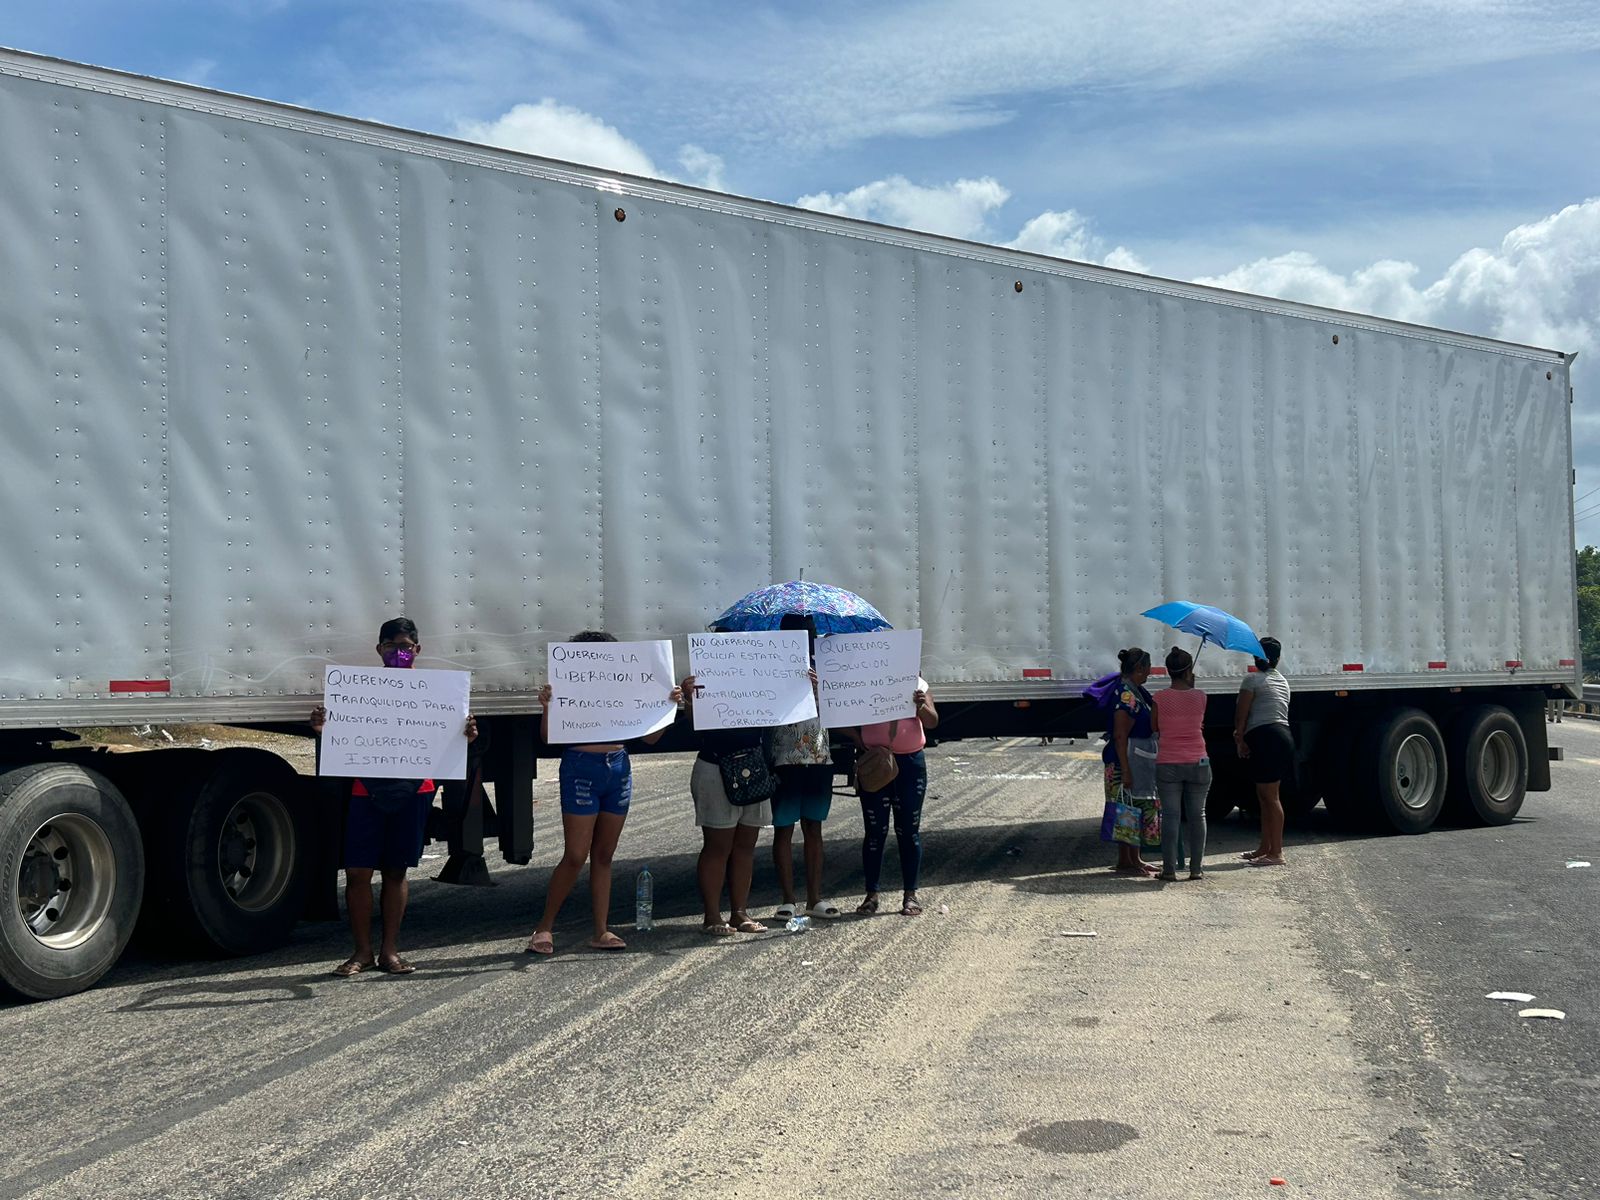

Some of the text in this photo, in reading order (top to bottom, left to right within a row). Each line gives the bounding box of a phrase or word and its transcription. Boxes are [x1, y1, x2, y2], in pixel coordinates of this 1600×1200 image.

[691, 637, 801, 650] NO QUEREMOS A LA
[820, 639, 890, 655] QUEREMOS
[552, 646, 640, 664] QUEREMOS LA
[691, 647, 736, 660] POLICIA
[789, 654, 808, 664] QUE
[327, 669, 428, 690] QUEREMOS LA
[555, 667, 655, 684] LIBERACION DE
[752, 668, 808, 679] NUESTRA
[822, 679, 867, 692] ABRAZOS
[870, 679, 884, 687] NO
[330, 693, 456, 712] TRANQUILIDAD PARA
[557, 697, 624, 709] FRANCISCO
[823, 697, 866, 708] FUERA
[328, 710, 388, 725] NUESTRAS
[712, 702, 775, 719] POLICIAS
[331, 735, 428, 750] NO QUEREMOS
